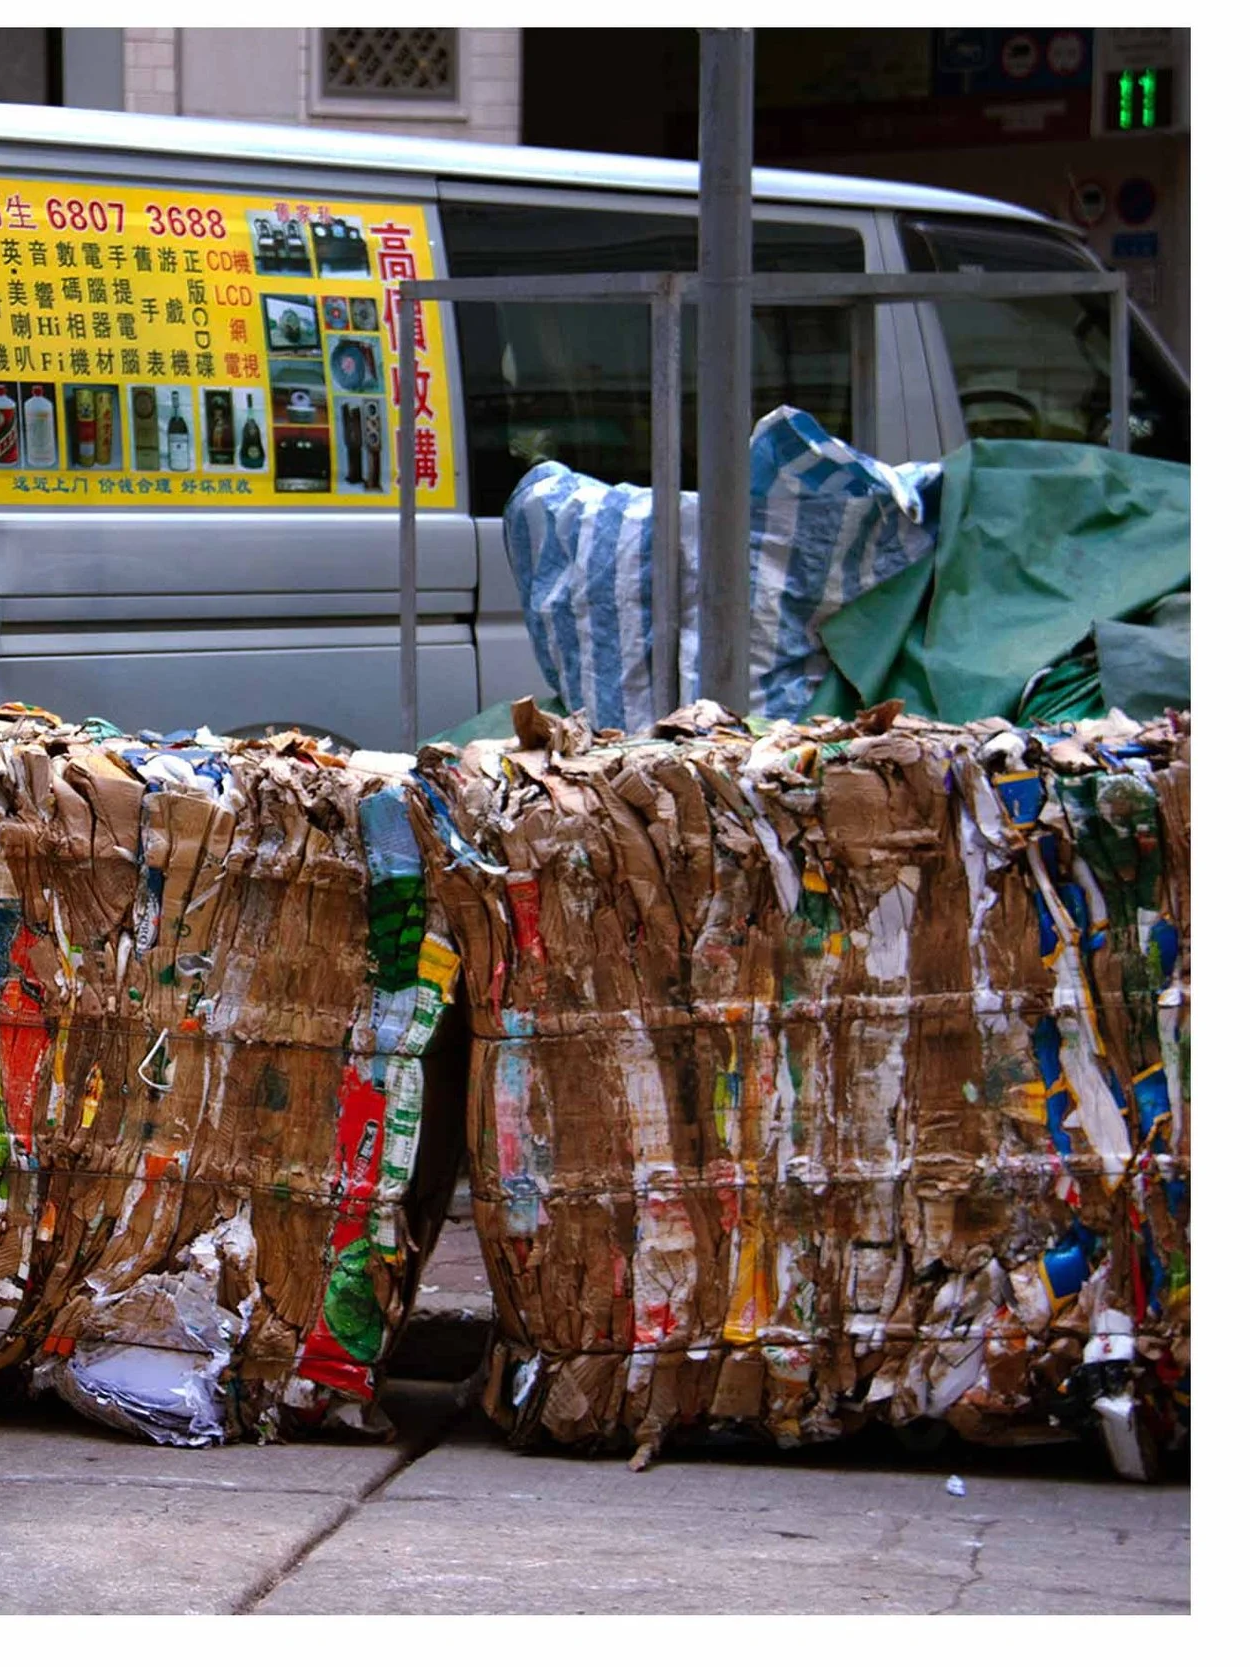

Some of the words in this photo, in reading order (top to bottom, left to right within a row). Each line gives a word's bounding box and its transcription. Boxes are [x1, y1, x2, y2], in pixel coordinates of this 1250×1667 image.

[1118, 66, 1157, 130] 11
[45, 197, 123, 233] 6807
[145, 204, 227, 239] 3688
[214, 284, 254, 307] LCD
